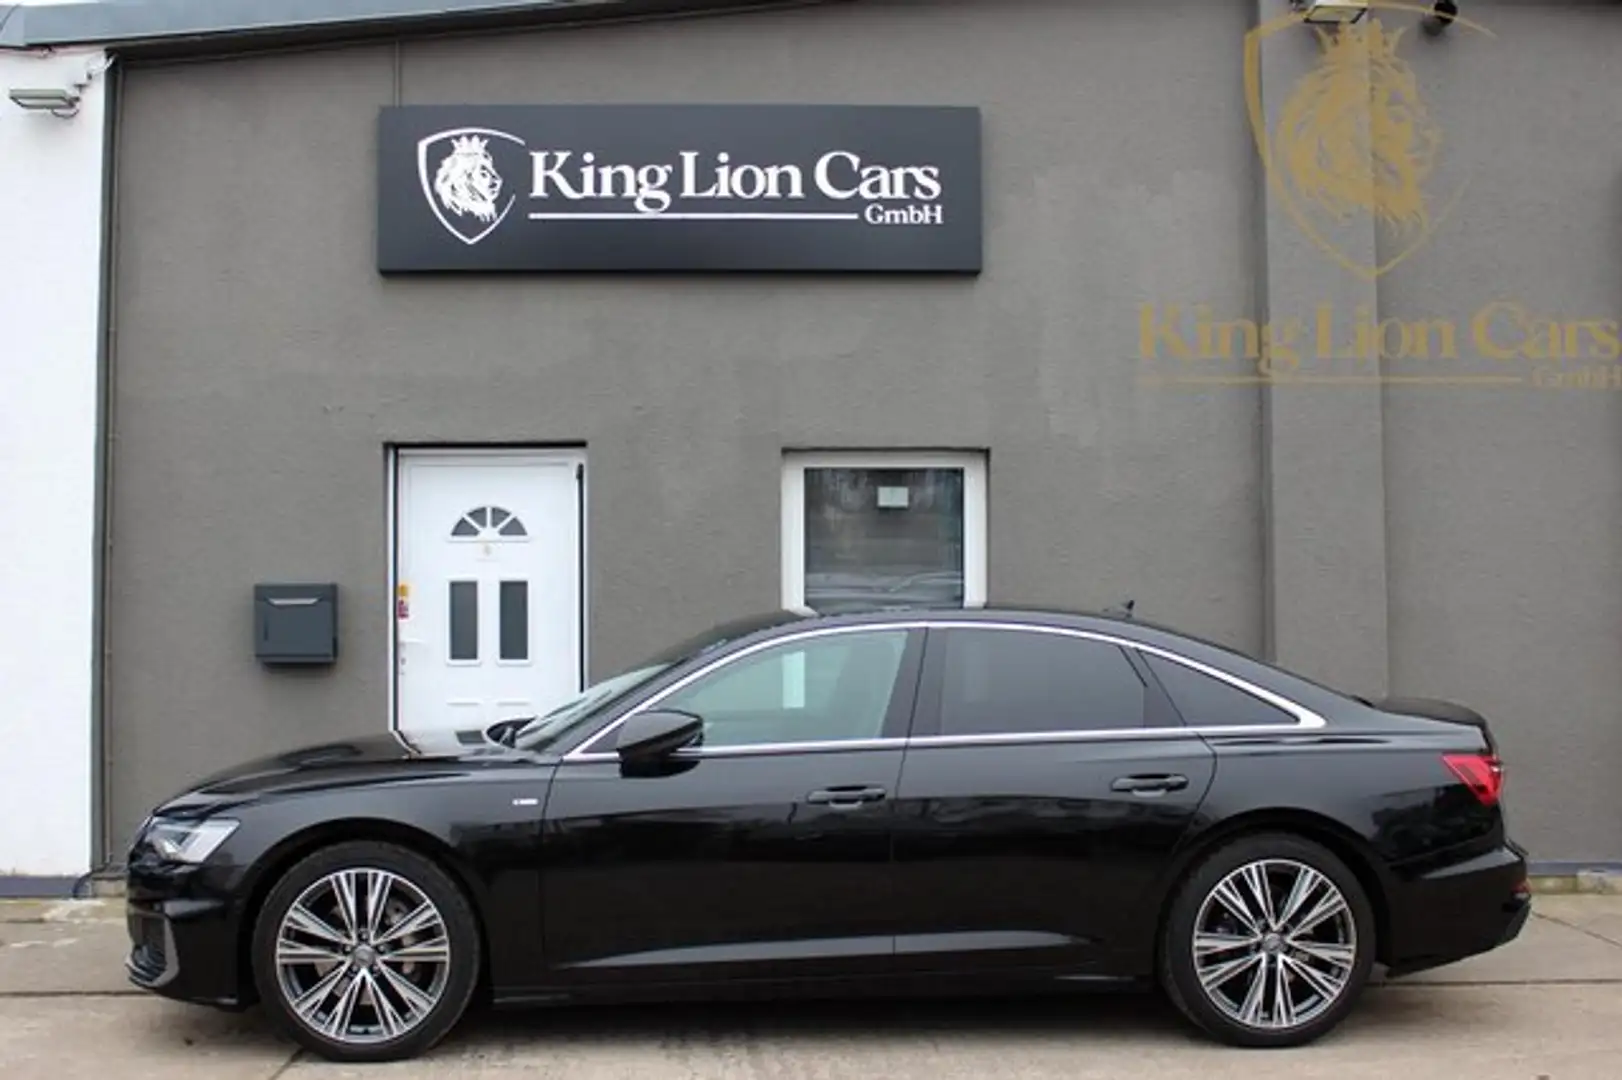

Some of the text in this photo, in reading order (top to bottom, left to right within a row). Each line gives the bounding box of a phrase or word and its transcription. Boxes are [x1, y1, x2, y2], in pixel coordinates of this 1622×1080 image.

[528, 150, 942, 213] King Lion Cars
[864, 203, 944, 225] GmbH
